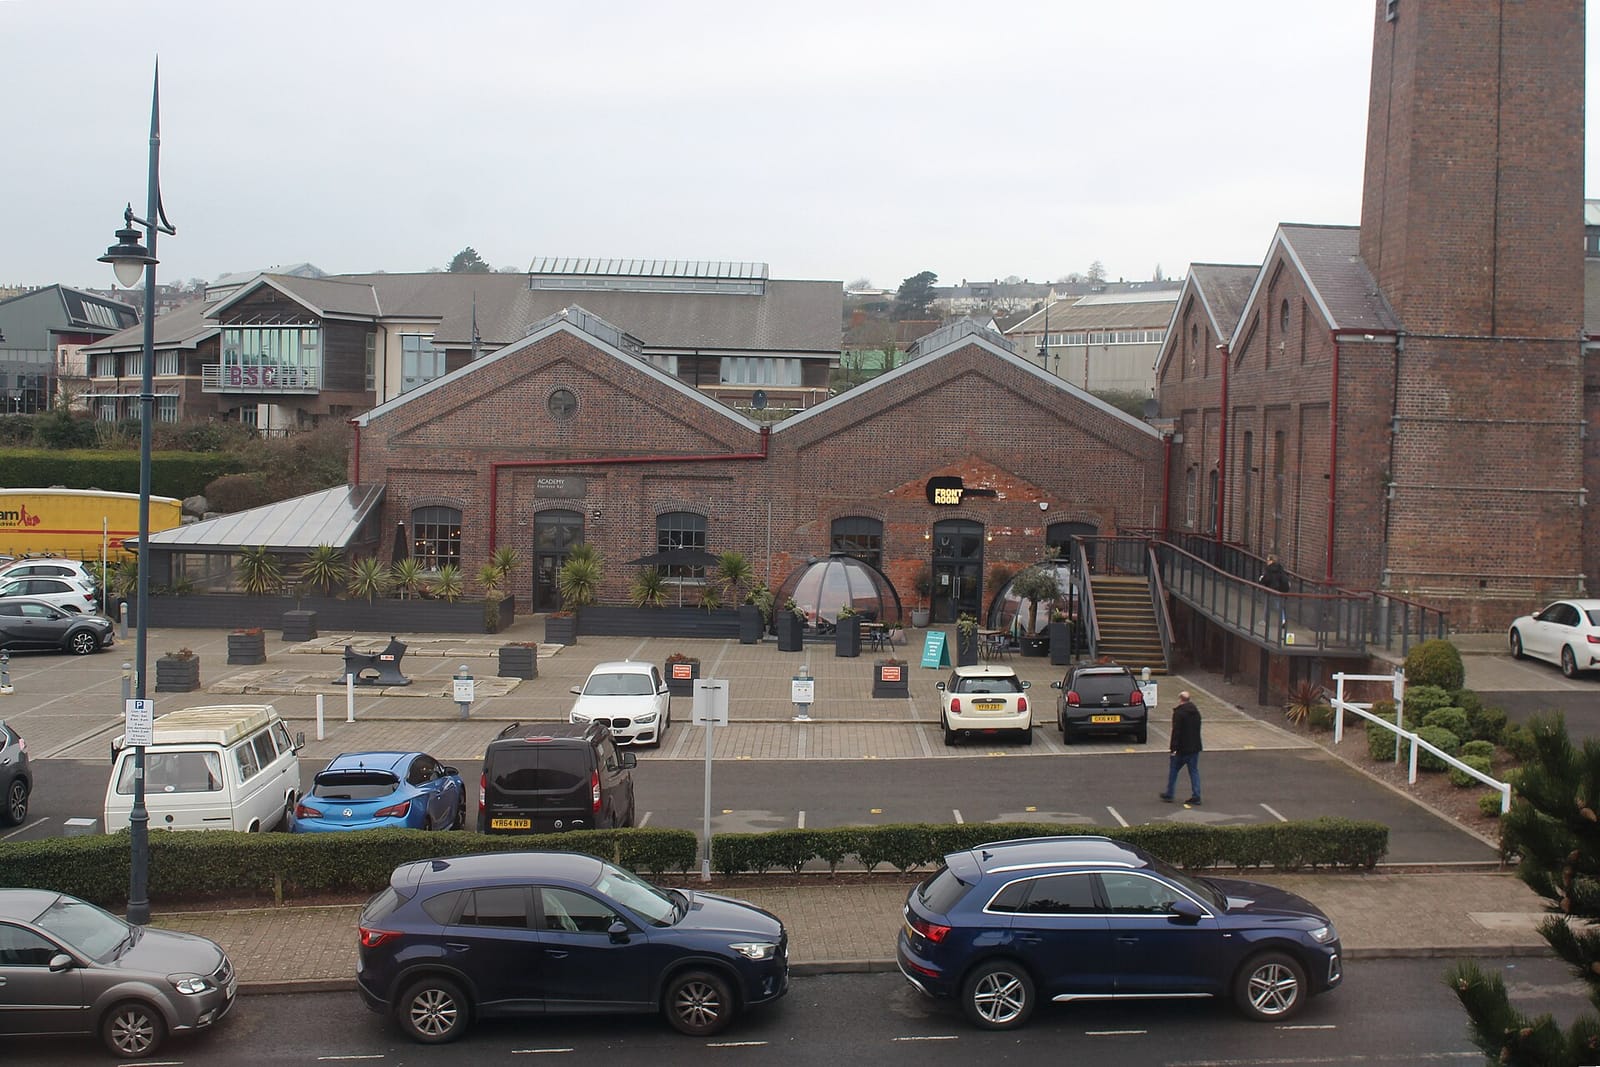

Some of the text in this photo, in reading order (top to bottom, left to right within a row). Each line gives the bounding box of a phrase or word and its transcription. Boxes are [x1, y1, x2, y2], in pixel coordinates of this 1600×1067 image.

[935, 488, 964, 497] FRONT
[935, 496, 959, 504] ROOM
[494, 819, 512, 827] YR64
